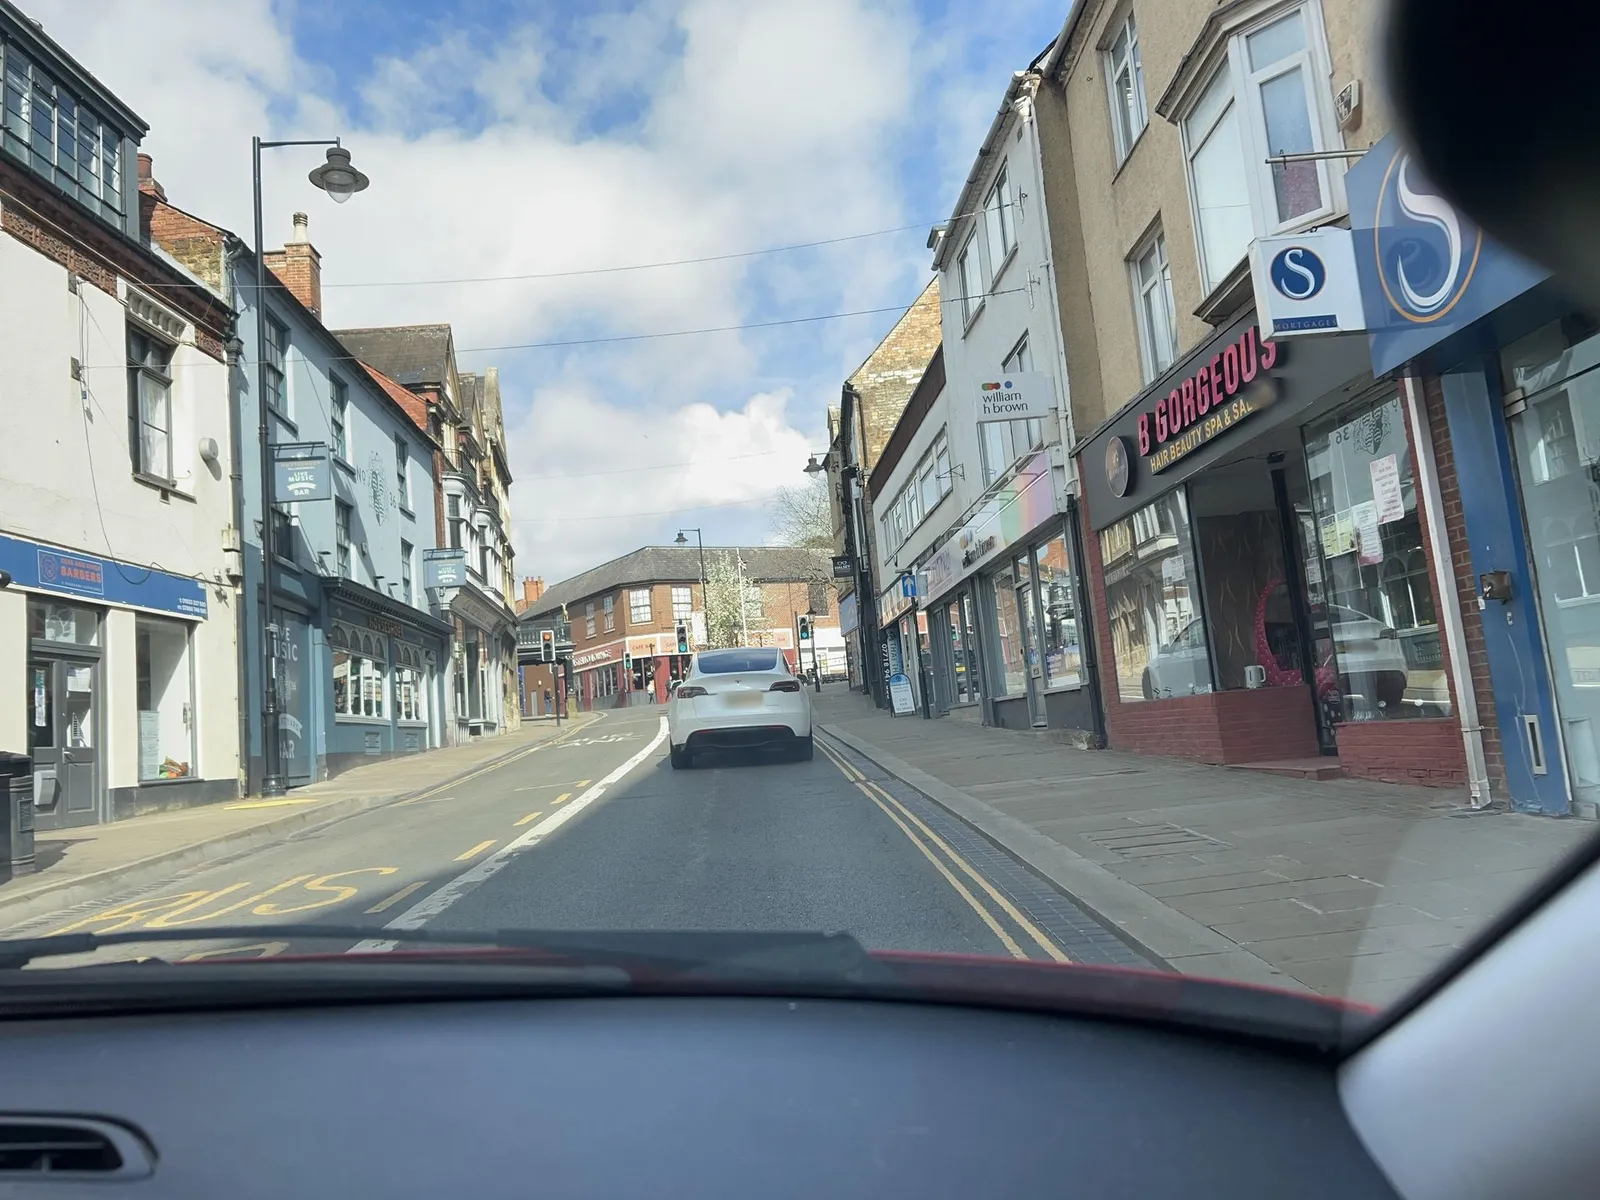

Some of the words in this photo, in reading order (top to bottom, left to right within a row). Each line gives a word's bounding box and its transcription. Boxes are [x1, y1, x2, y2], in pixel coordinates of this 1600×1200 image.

[1281, 249, 1315, 299] S
[1274, 319, 1337, 331] MORTGAGES
[982, 391, 1022, 404] william
[1137, 412, 1150, 457] B
[1154, 325, 1277, 444] GORGEOUS
[983, 403, 990, 415] h
[992, 402, 1029, 414] brown
[1150, 450, 1170, 472] HAIR
[1170, 426, 1202, 461] BEAUTY
[1204, 416, 1223, 438] SPA
[1223, 408, 1232, 426] &
[288, 474, 314, 482] MUSIC
[294, 488, 310, 496] BAR
[60, 565, 103, 584] BARBERS
